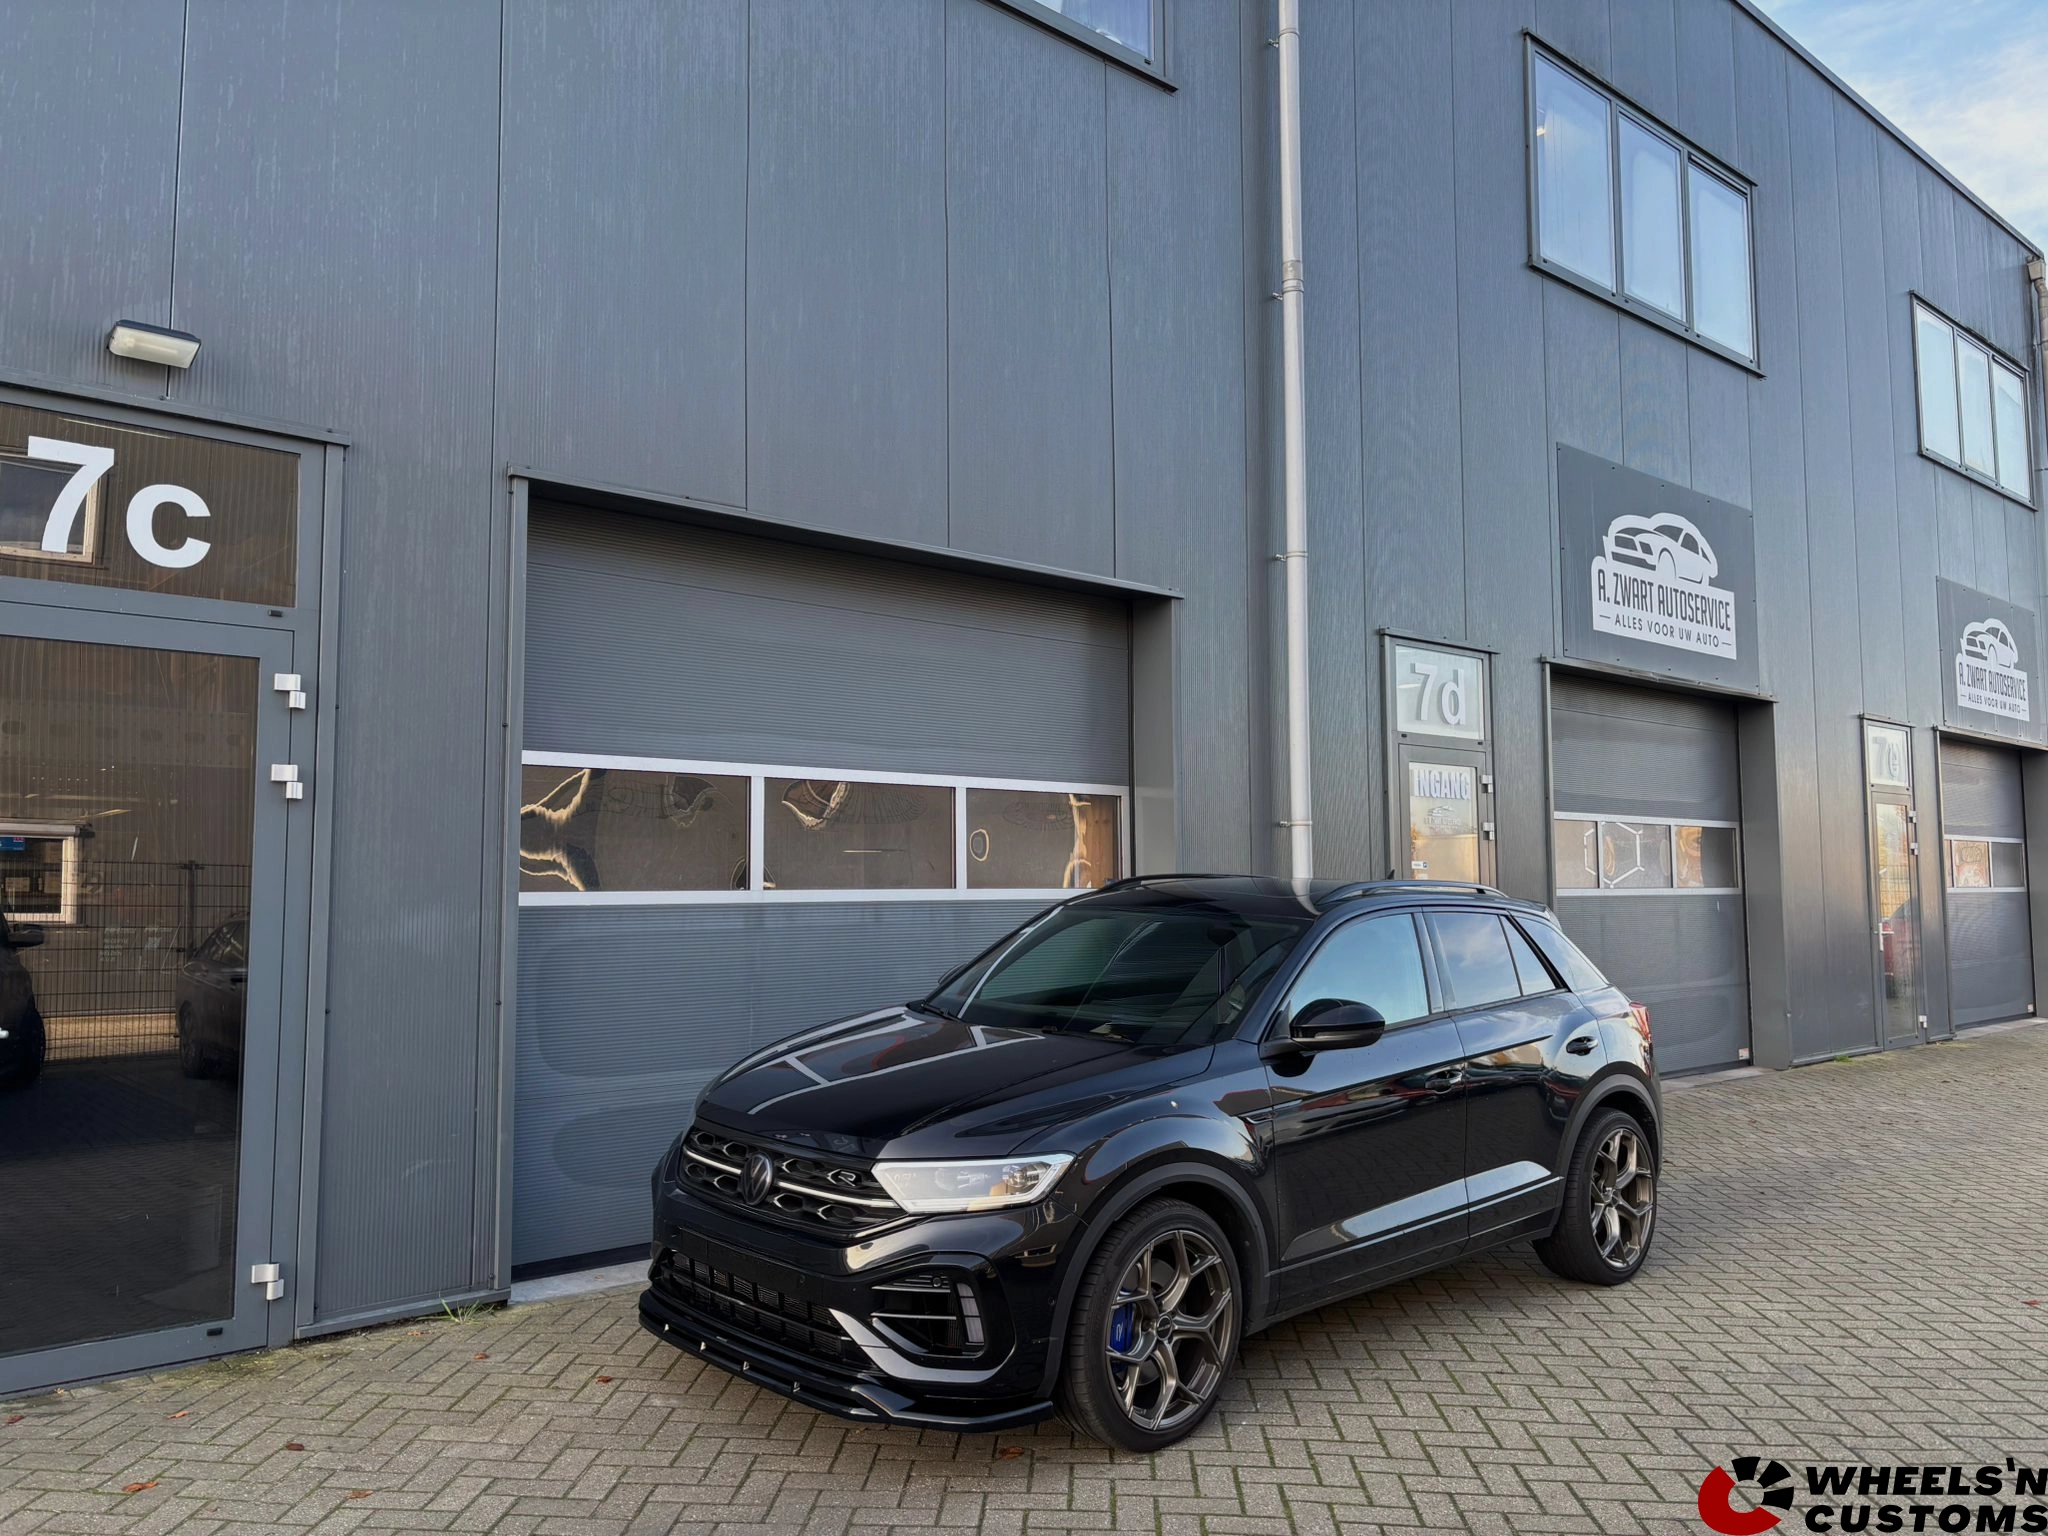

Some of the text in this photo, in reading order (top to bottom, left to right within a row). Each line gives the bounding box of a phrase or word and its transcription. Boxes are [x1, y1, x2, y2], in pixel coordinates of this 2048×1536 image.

[27, 435, 211, 569] 7c
[1598, 568, 1731, 632] A. ZWART AUTOSERVICE
[1615, 613, 1719, 648] ALLES VOOR UW AUTO
[1412, 662, 1466, 726] 7d
[1967, 664, 1988, 691] ZWART
[1989, 670, 2026, 701] AUTOSERVICE
[1968, 693, 1983, 705] ALLES
[1984, 696, 1999, 708] VOOR
[2008, 702, 2021, 714] AUTO
[1414, 768, 1471, 801] INGANG
